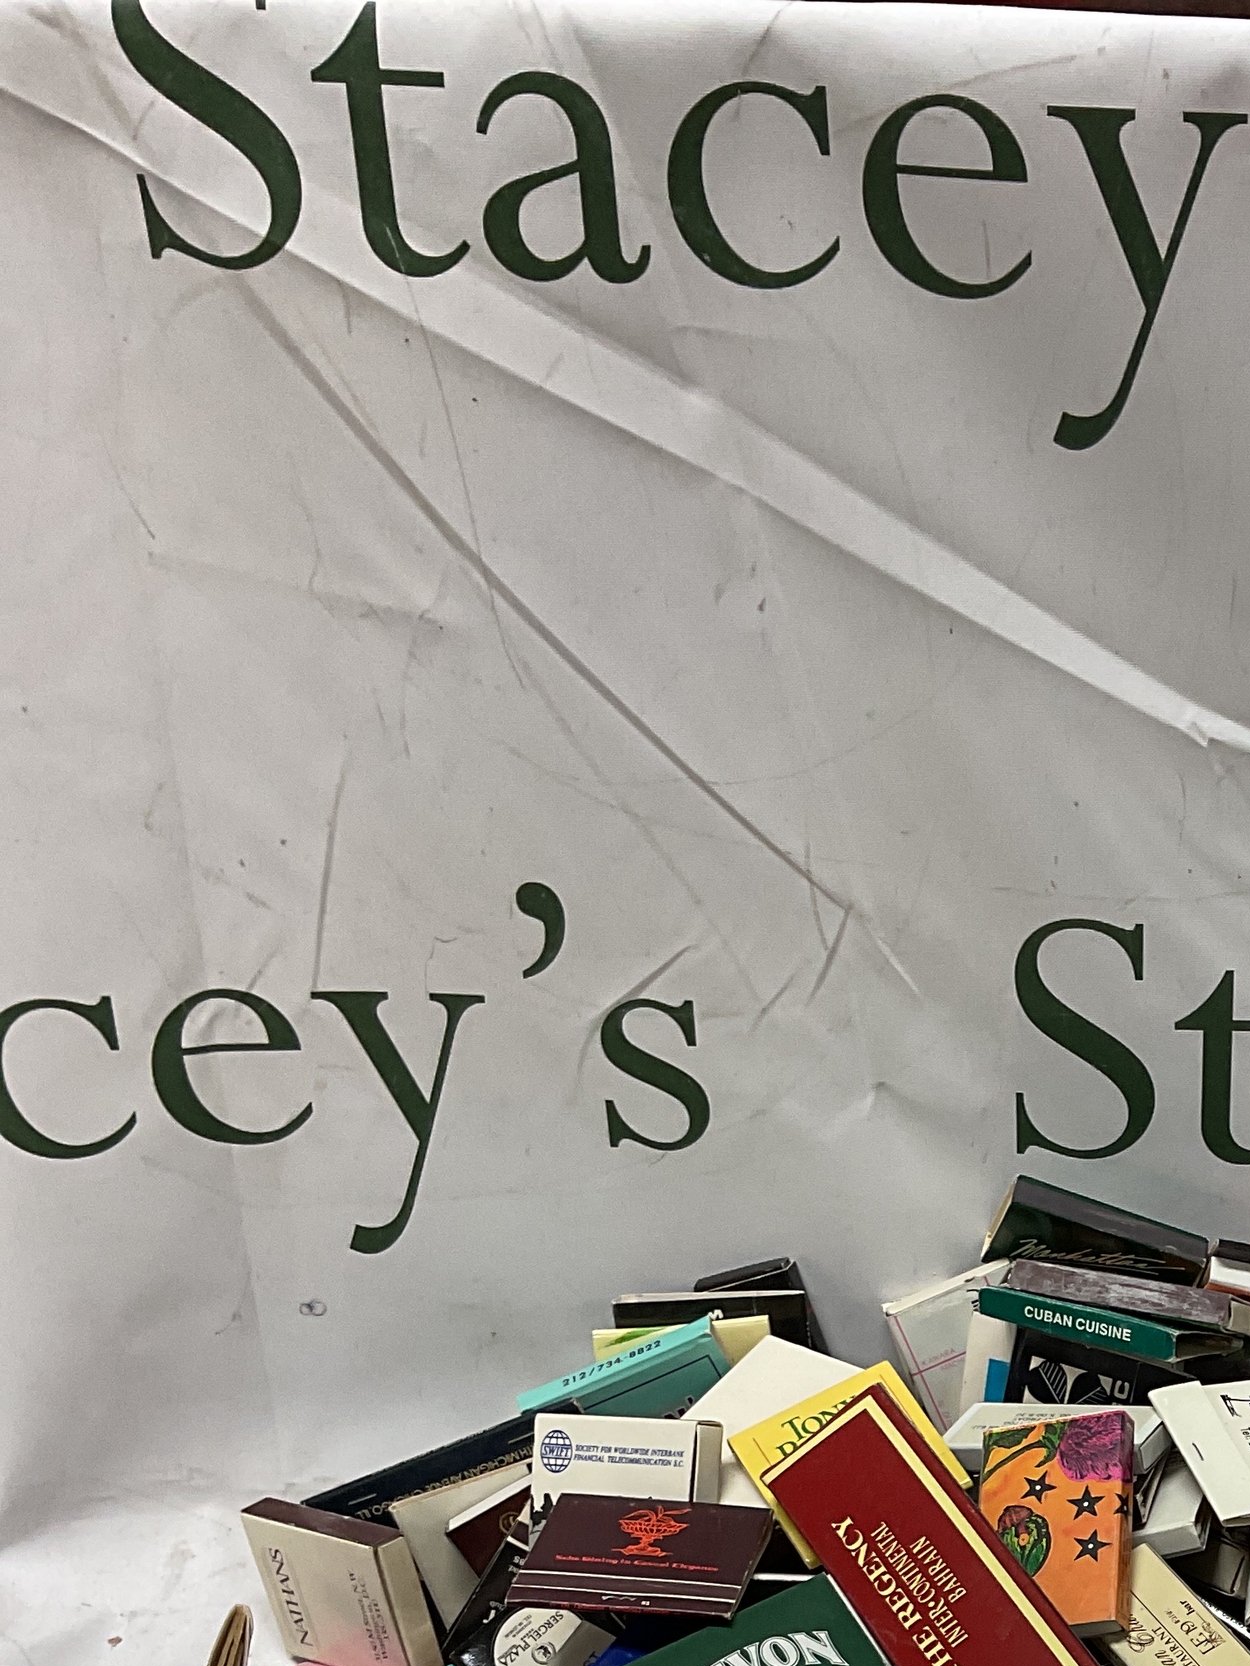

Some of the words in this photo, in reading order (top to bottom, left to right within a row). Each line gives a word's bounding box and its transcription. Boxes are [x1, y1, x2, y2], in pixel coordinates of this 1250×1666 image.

[1008, 1238, 1186, 1276] Manhattan
[1023, 1305, 1074, 1330] CUBAN
[1074, 1316, 1132, 1342] CUISINE
[542, 1444, 571, 1458] SWIFT
[831, 1517, 921, 1631] REGENCY
[910, 1535, 968, 1604] BAHRAIN
[267, 1547, 314, 1648] NATHANS
[532, 1611, 564, 1640] SERGEL
[499, 1634, 532, 1666] PLAZA
